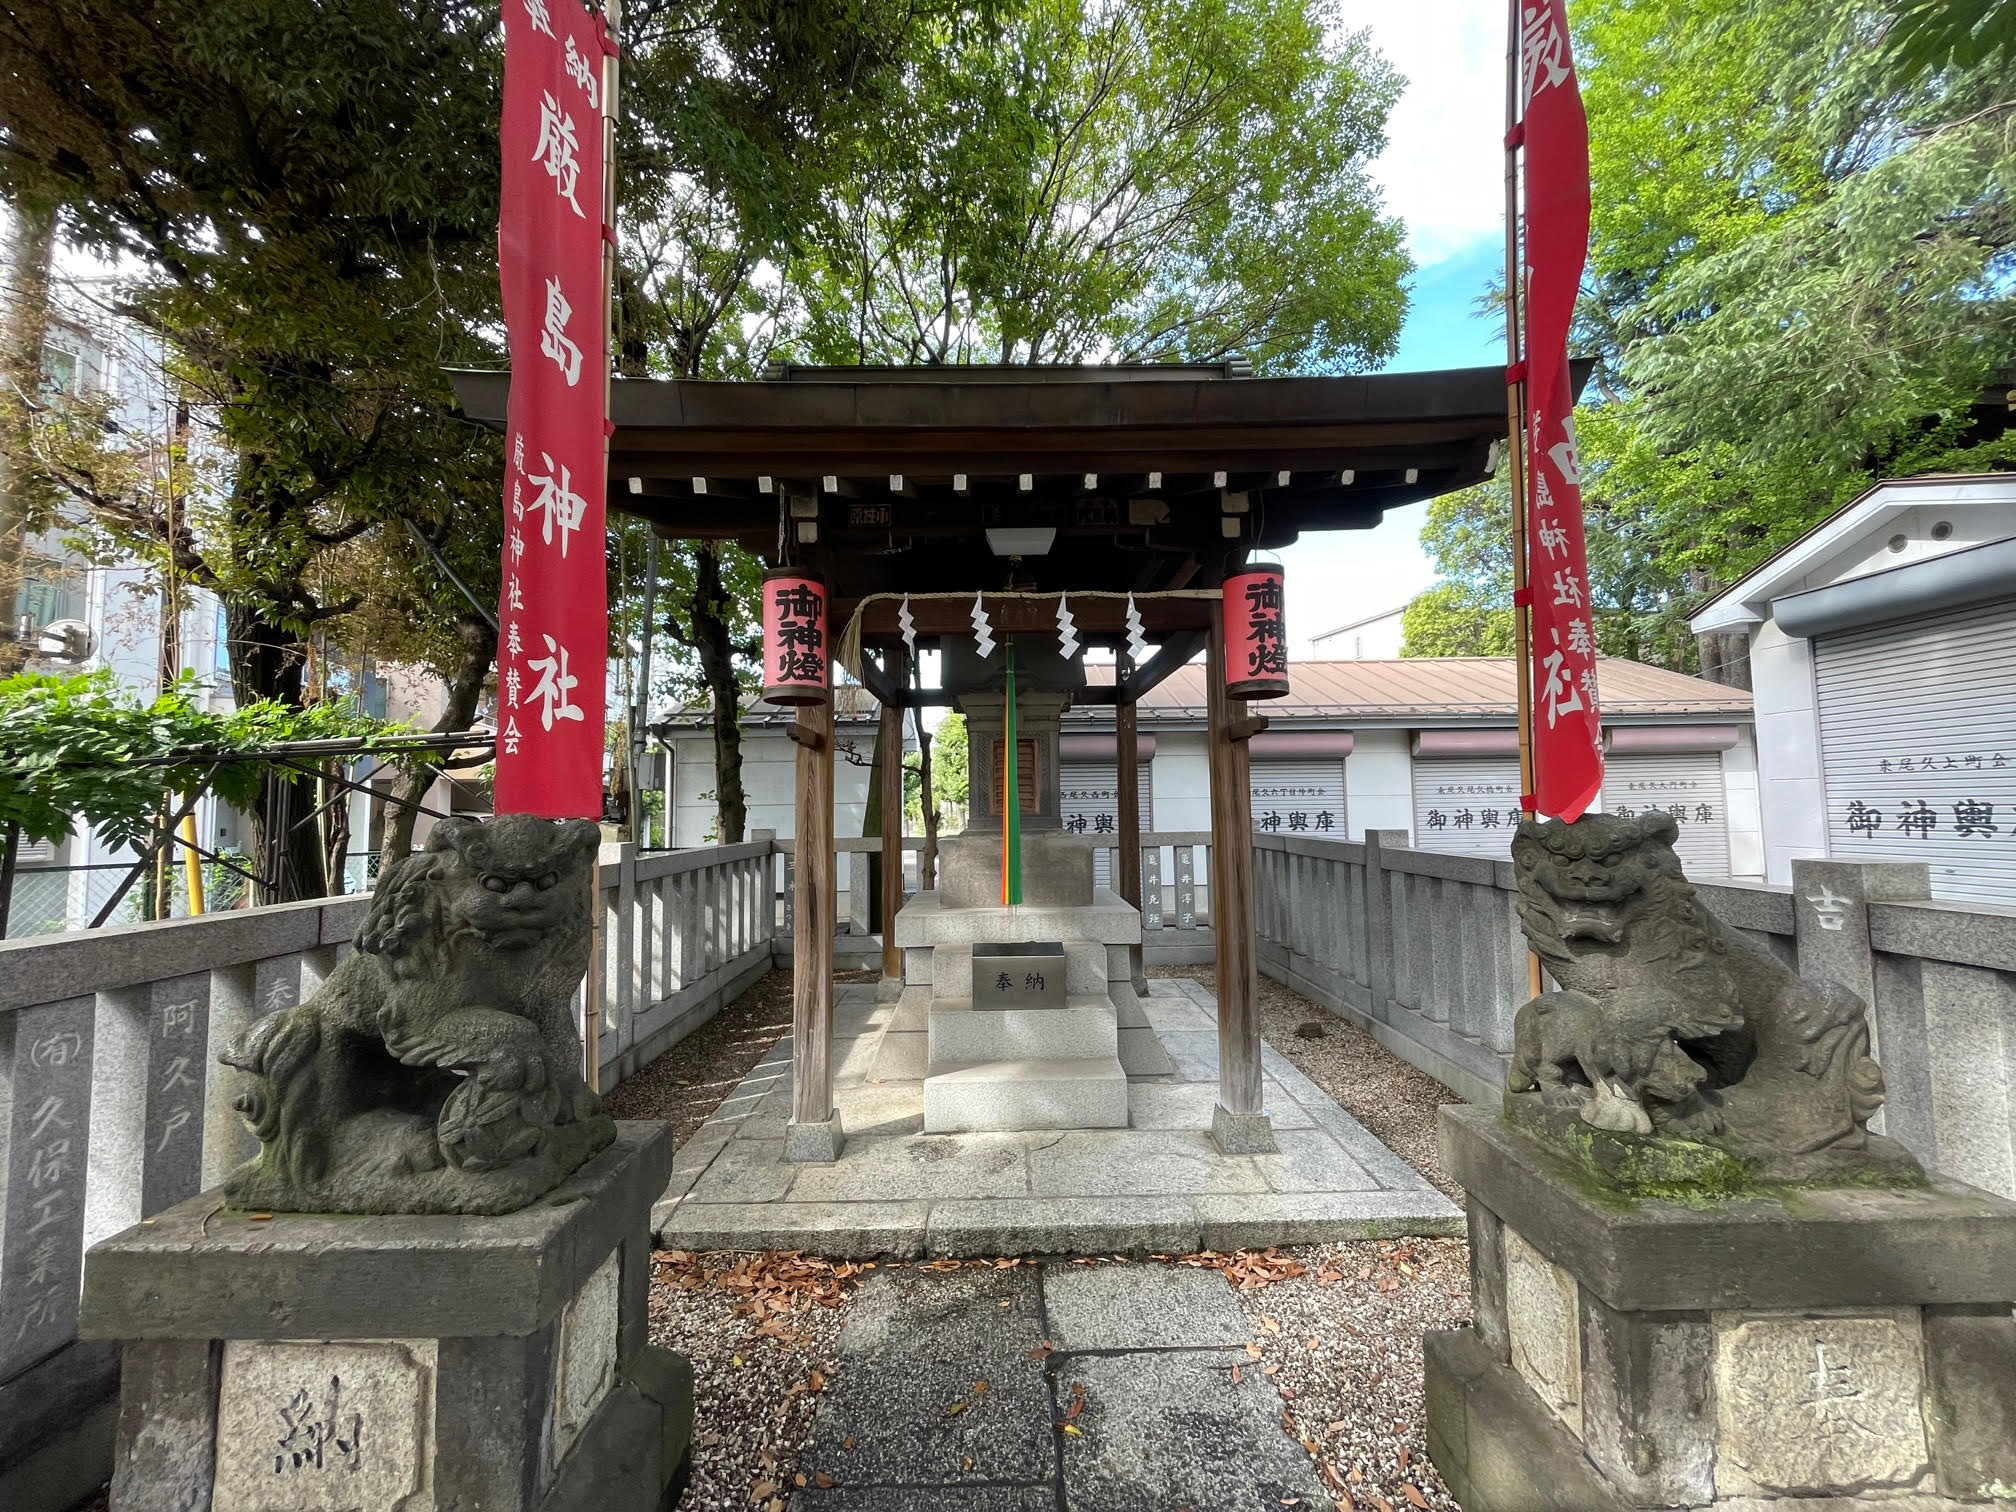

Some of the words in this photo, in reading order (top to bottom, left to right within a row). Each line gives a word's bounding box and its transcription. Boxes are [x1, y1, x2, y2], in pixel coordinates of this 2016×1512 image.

[524, 89, 588, 732] 厳島神社
[503, 432, 527, 755] 厳島神社奉賛会
[774, 583, 825, 683] 御神燈
[1616, 802, 1715, 824] 御輿庫
[1845, 799, 2016, 841] 御神輿
[1805, 884, 1854, 931] 吉
[995, 970, 1045, 992] 奉納
